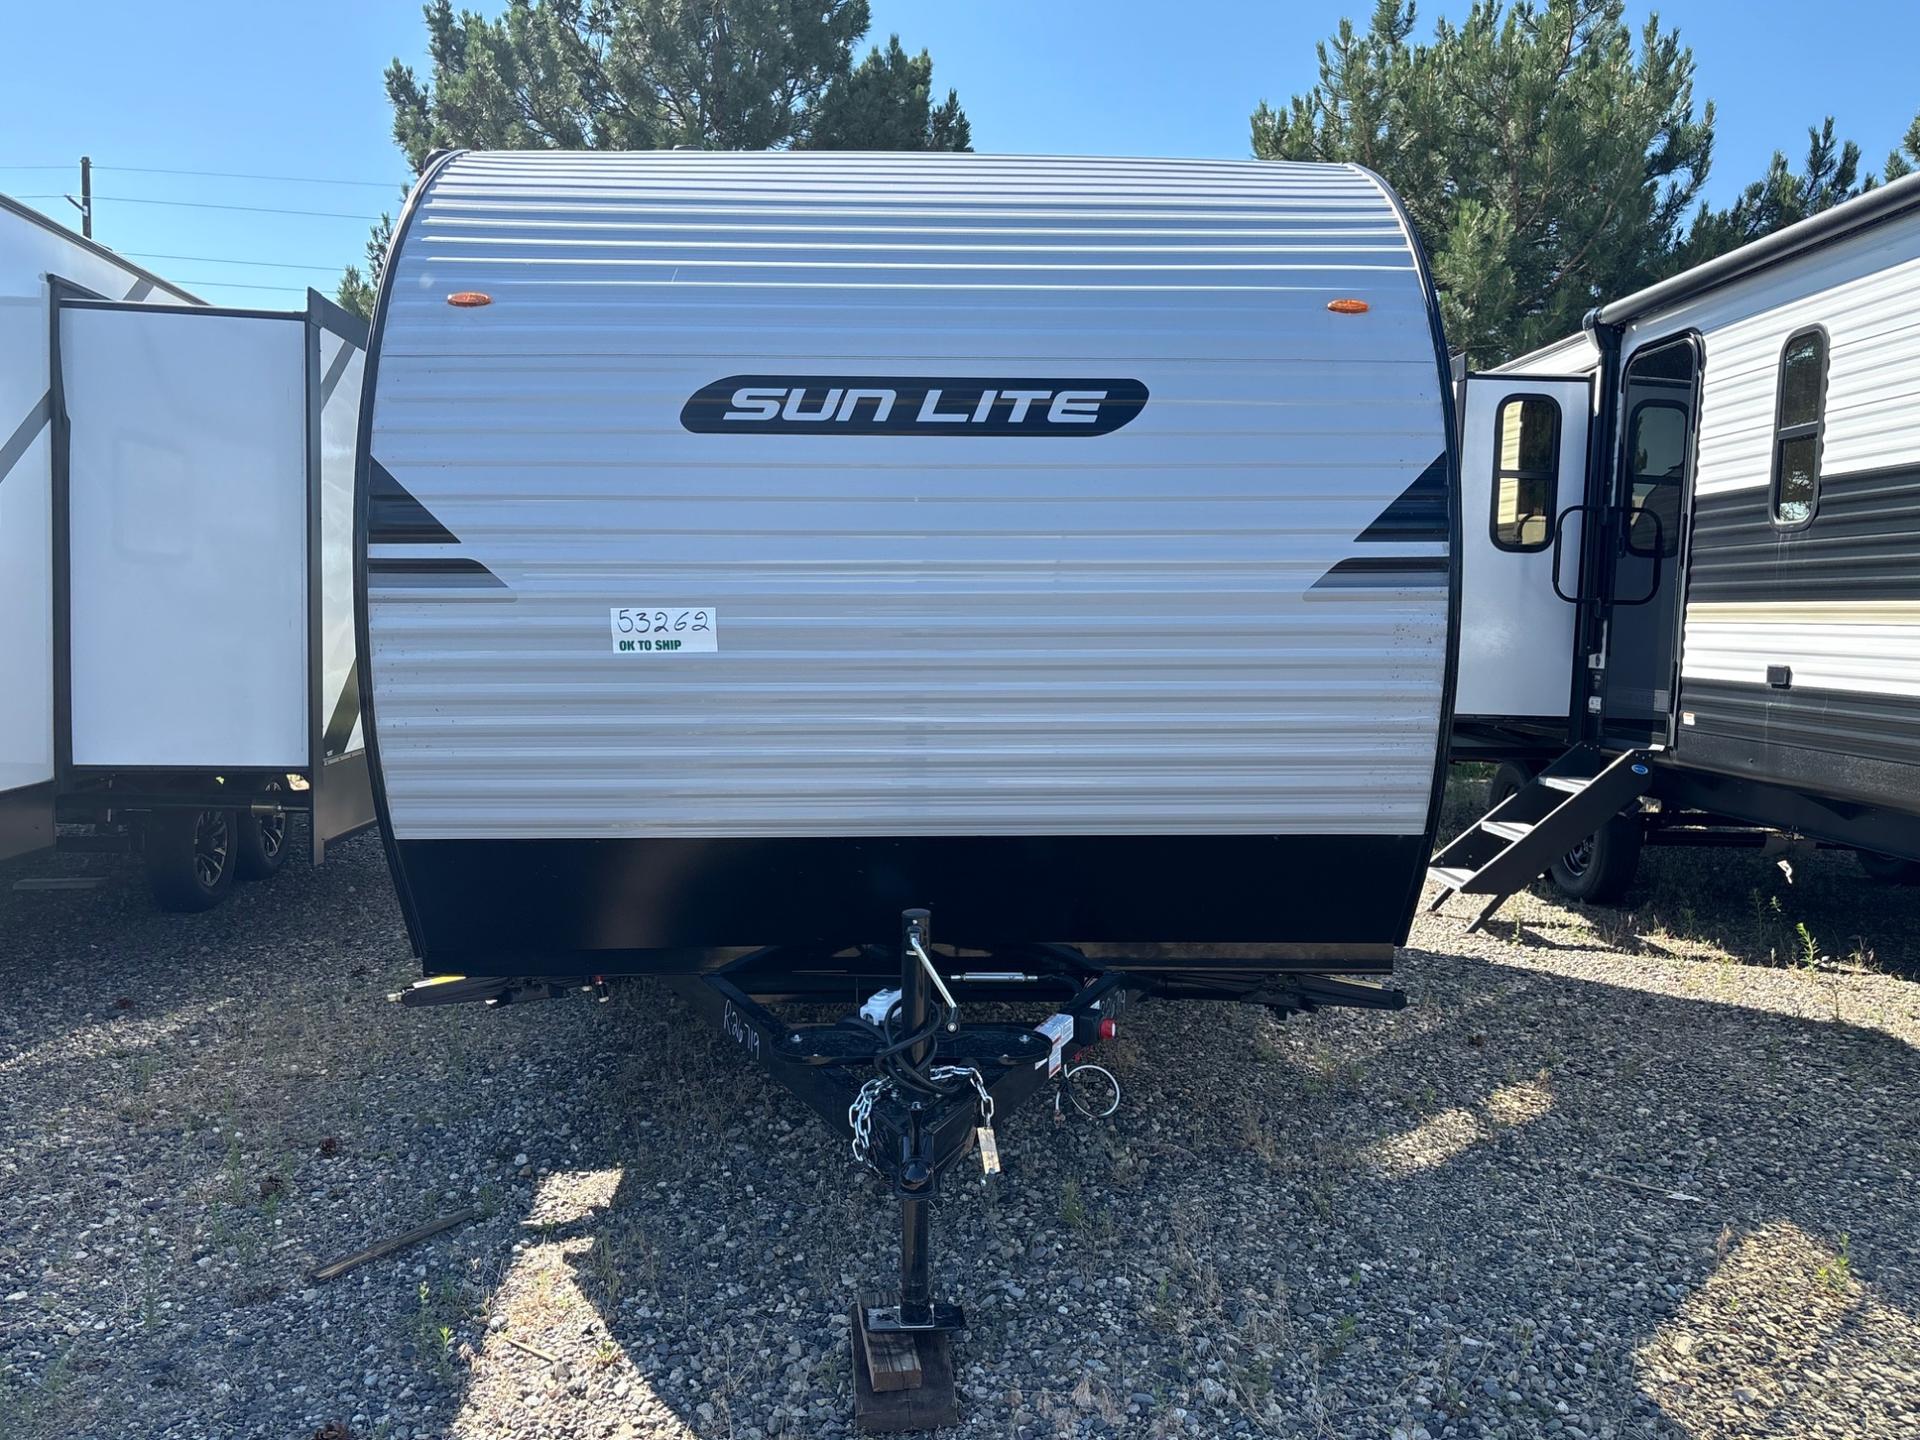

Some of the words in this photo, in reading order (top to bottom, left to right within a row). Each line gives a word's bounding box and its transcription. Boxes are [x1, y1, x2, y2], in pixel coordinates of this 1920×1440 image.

[722, 387, 897, 422] SUN
[915, 389, 1108, 424] LITE
[617, 608, 710, 634] 53262
[619, 640, 636, 652] OK
[638, 640, 652, 651] TO
[655, 639, 682, 651] SHIP
